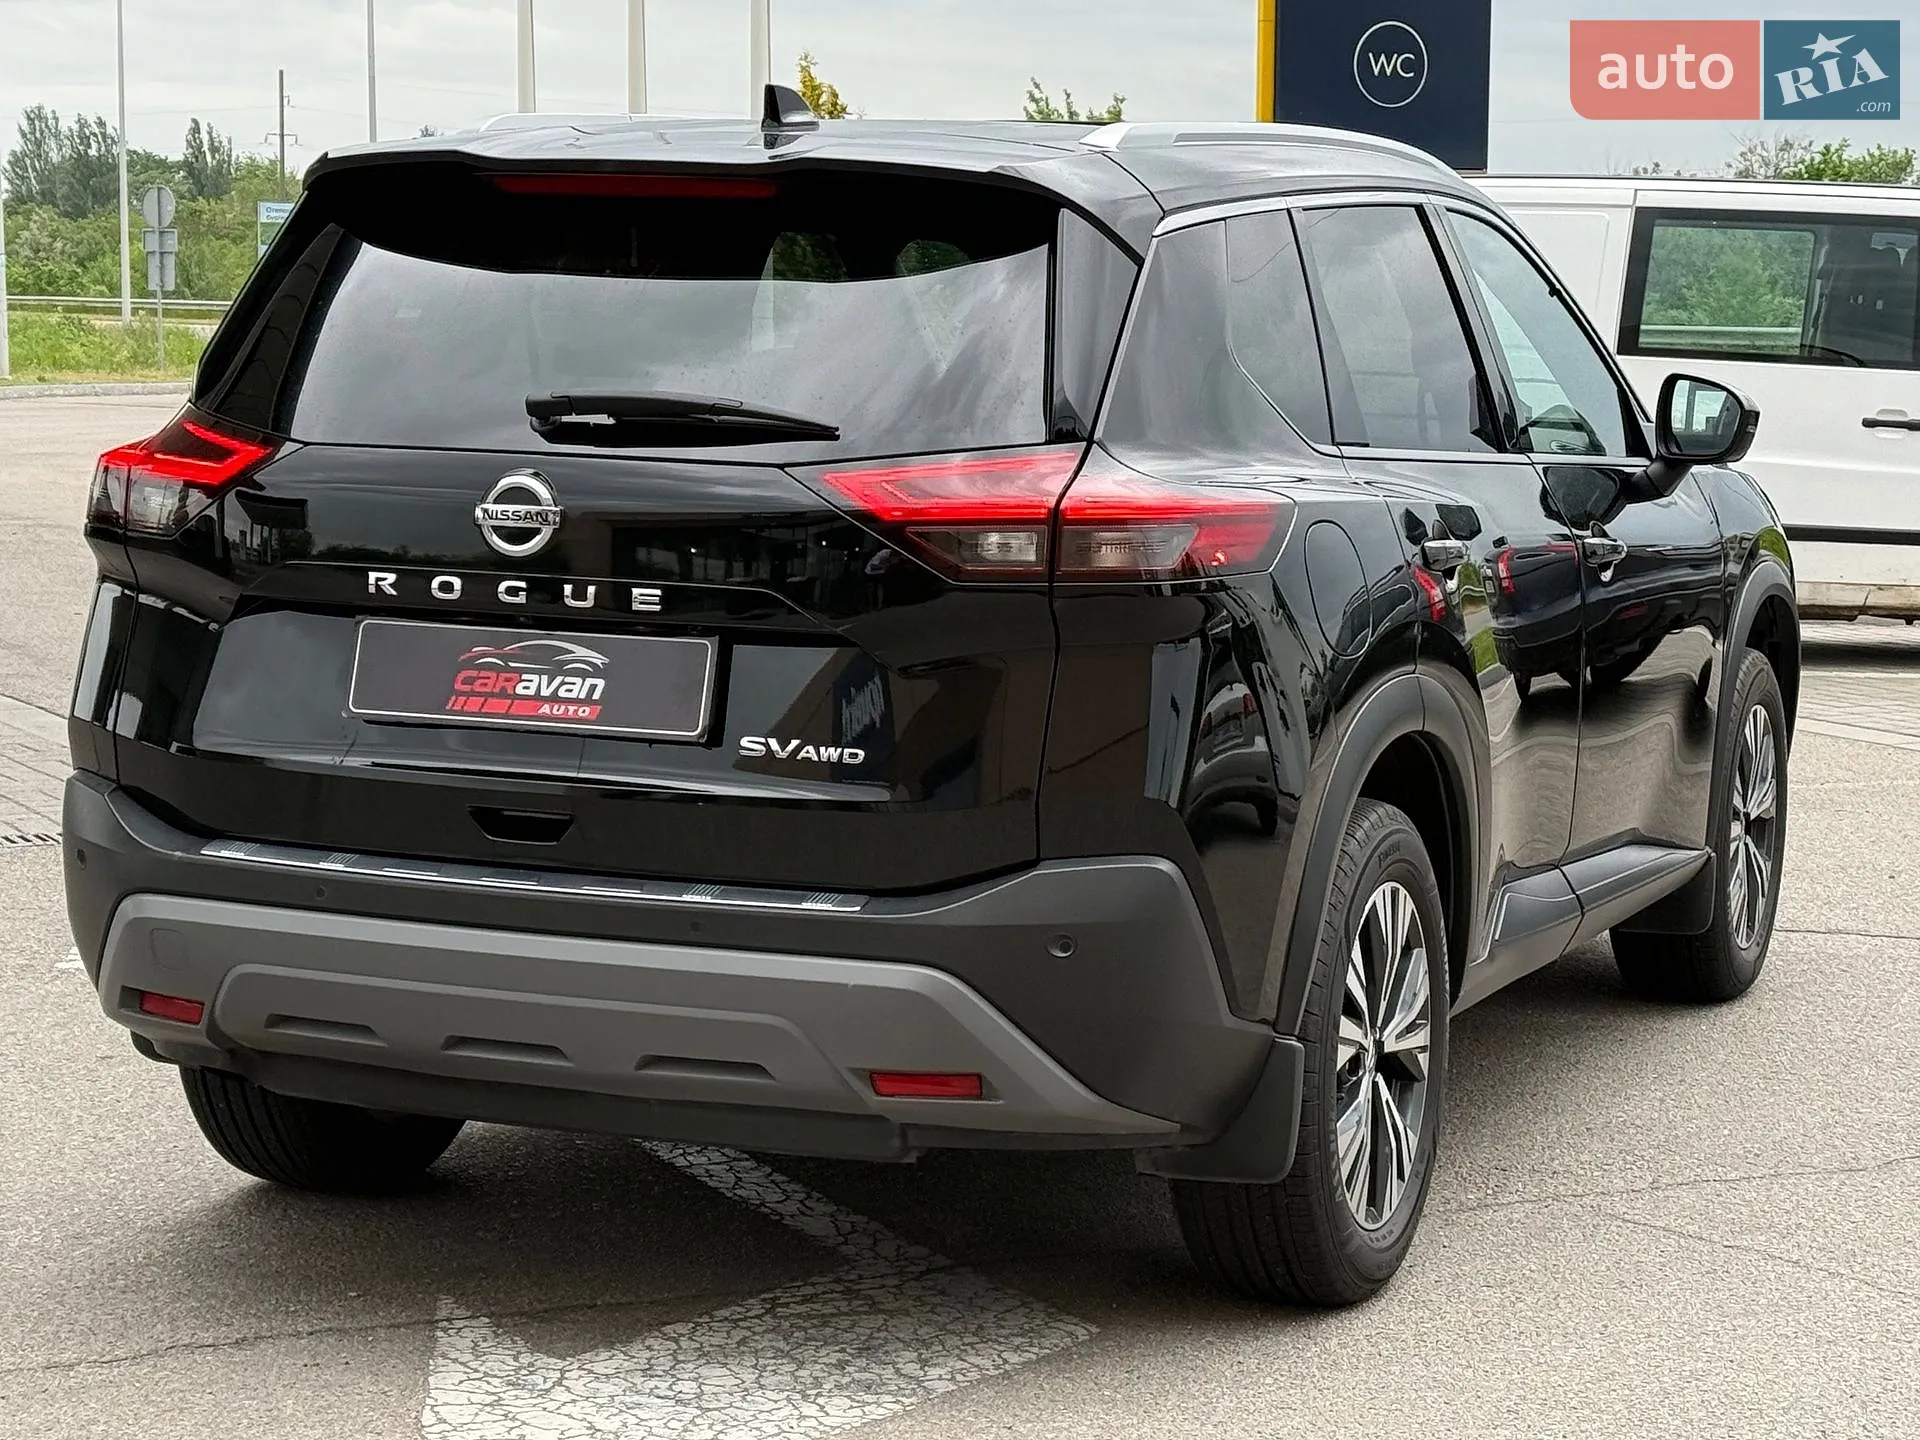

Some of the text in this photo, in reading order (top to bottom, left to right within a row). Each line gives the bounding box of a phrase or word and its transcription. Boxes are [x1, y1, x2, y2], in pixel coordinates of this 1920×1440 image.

[1368, 52, 1416, 77] WC
[482, 510, 550, 523] NISSAN
[368, 571, 662, 611] ROGUE
[537, 703, 591, 717] AUTO
